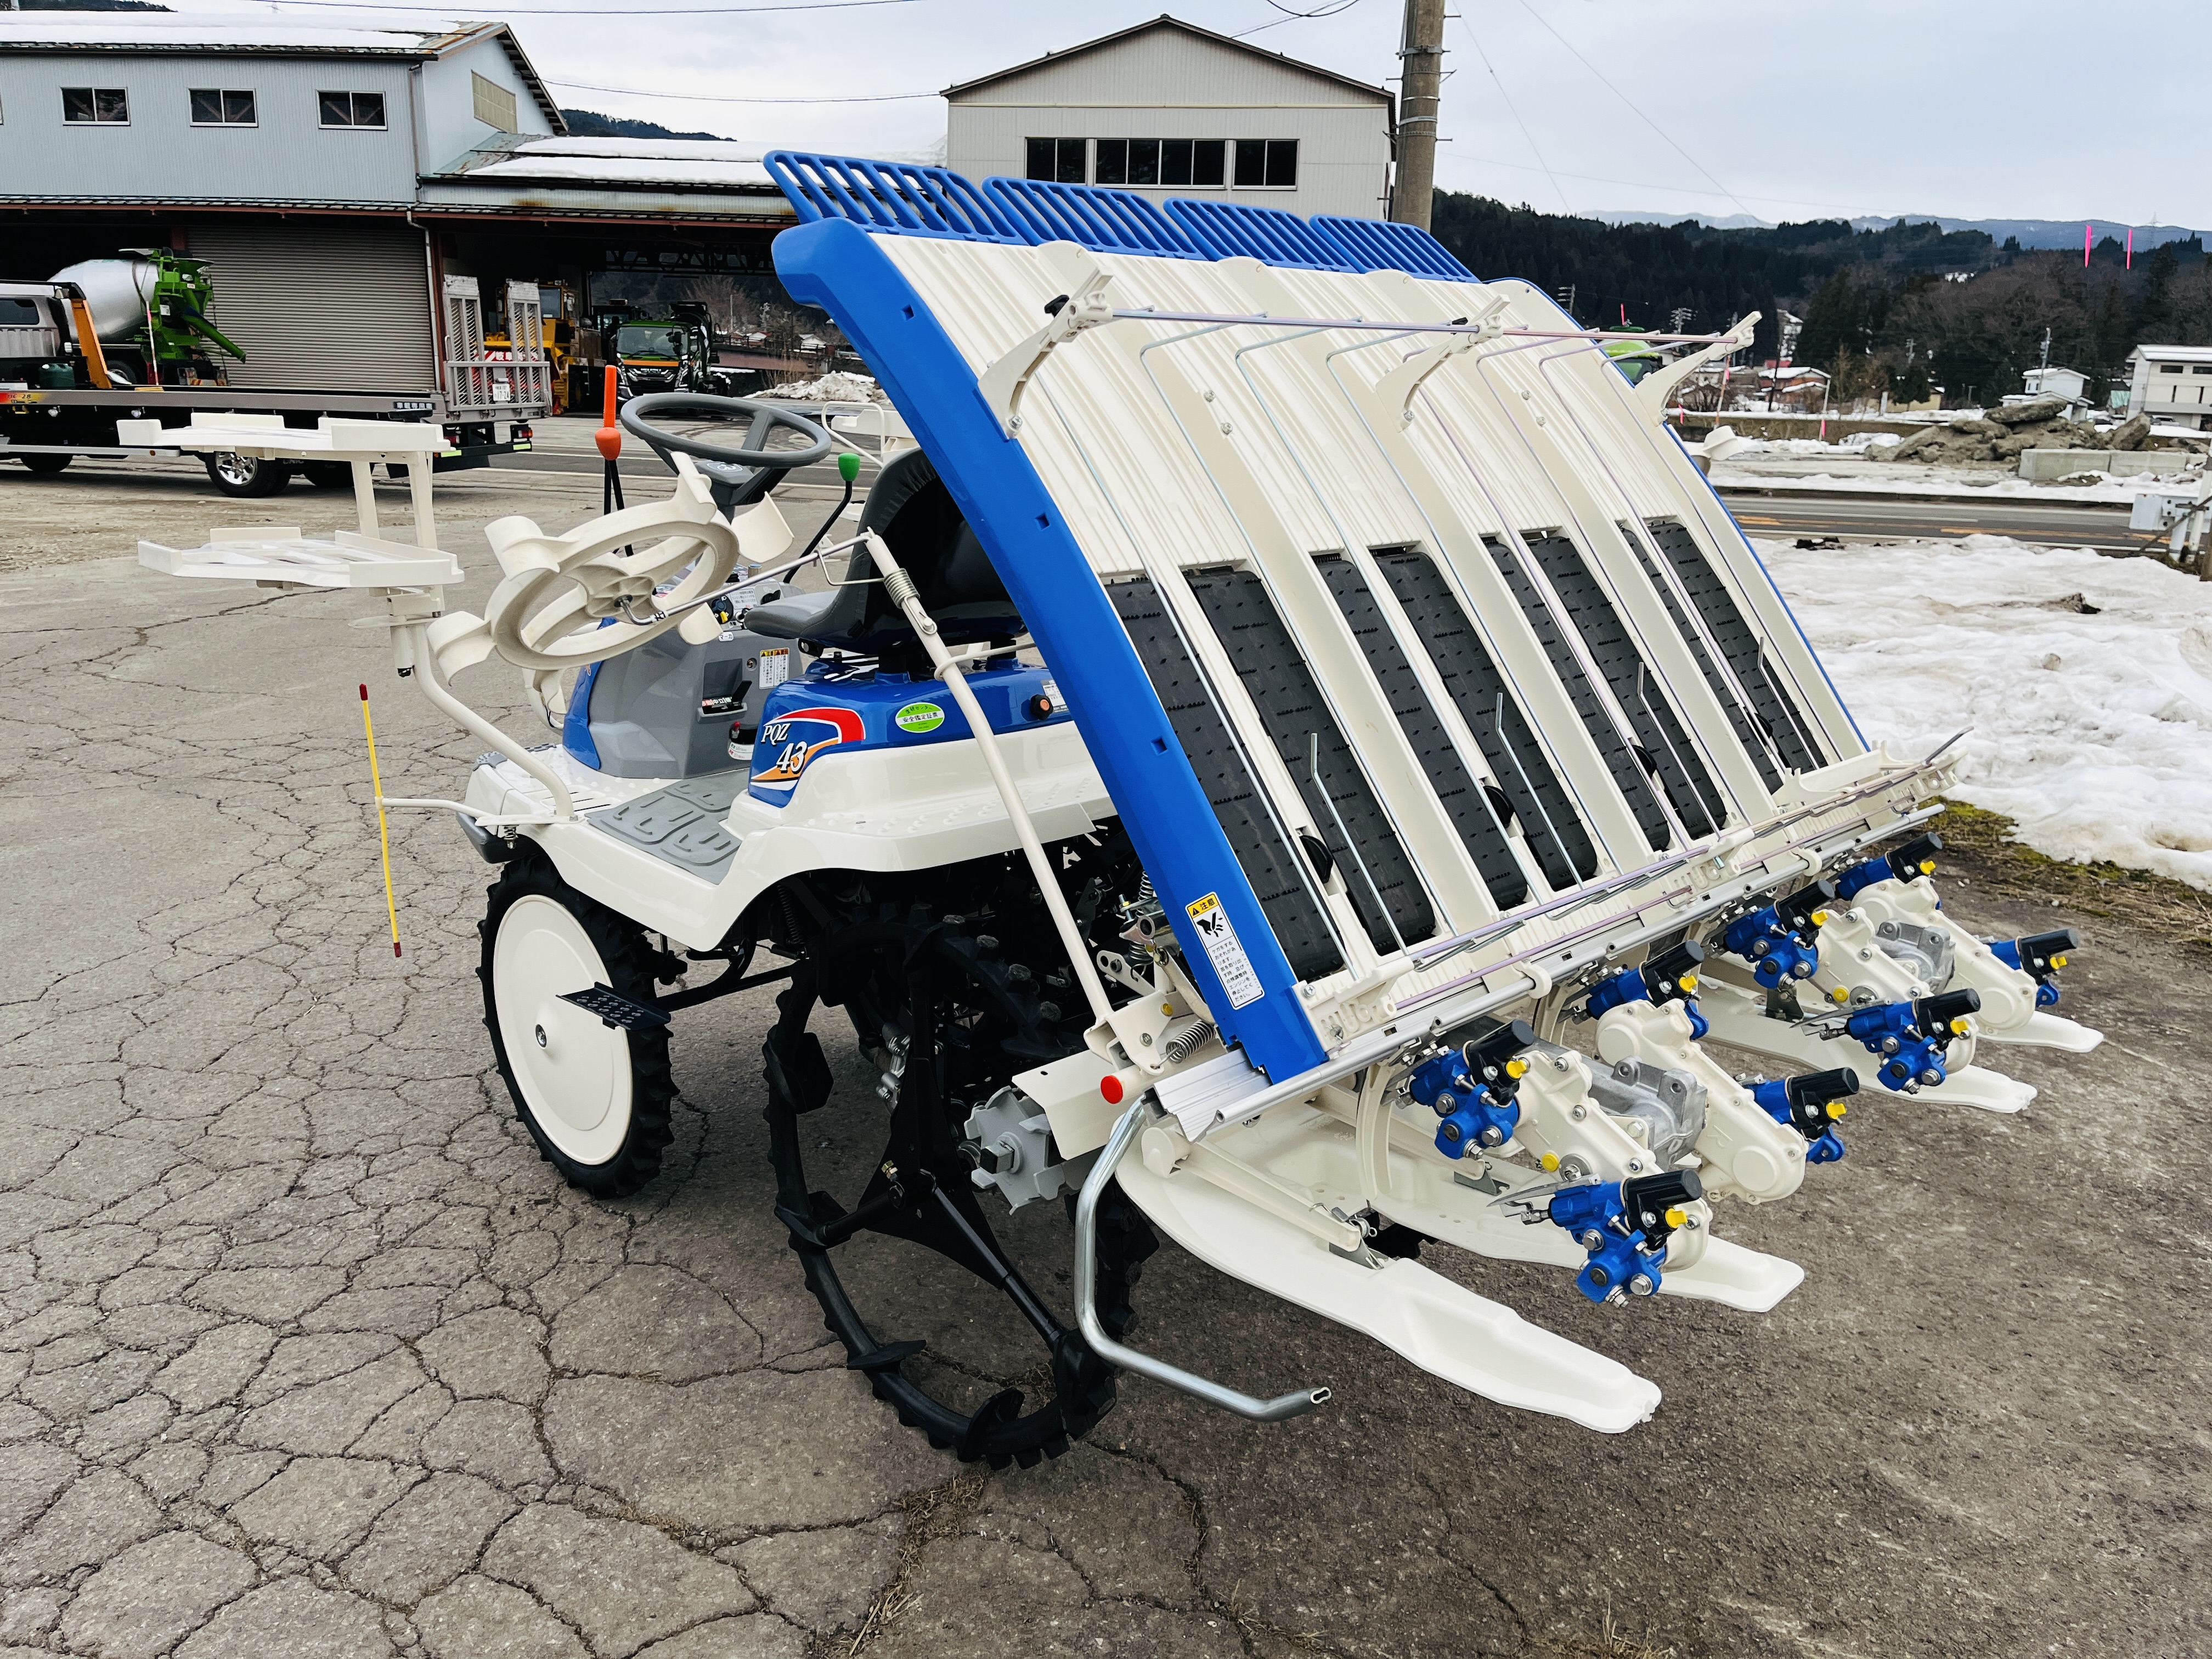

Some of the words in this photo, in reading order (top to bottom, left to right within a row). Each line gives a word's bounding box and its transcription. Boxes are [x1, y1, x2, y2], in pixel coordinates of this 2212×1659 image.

[760, 723, 791, 746] PQZ
[776, 741, 808, 774] 43
[1199, 898, 1216, 911] 注意
[1215, 947, 1236, 961] おそれがあ
[1229, 977, 1250, 990] エンジンを
